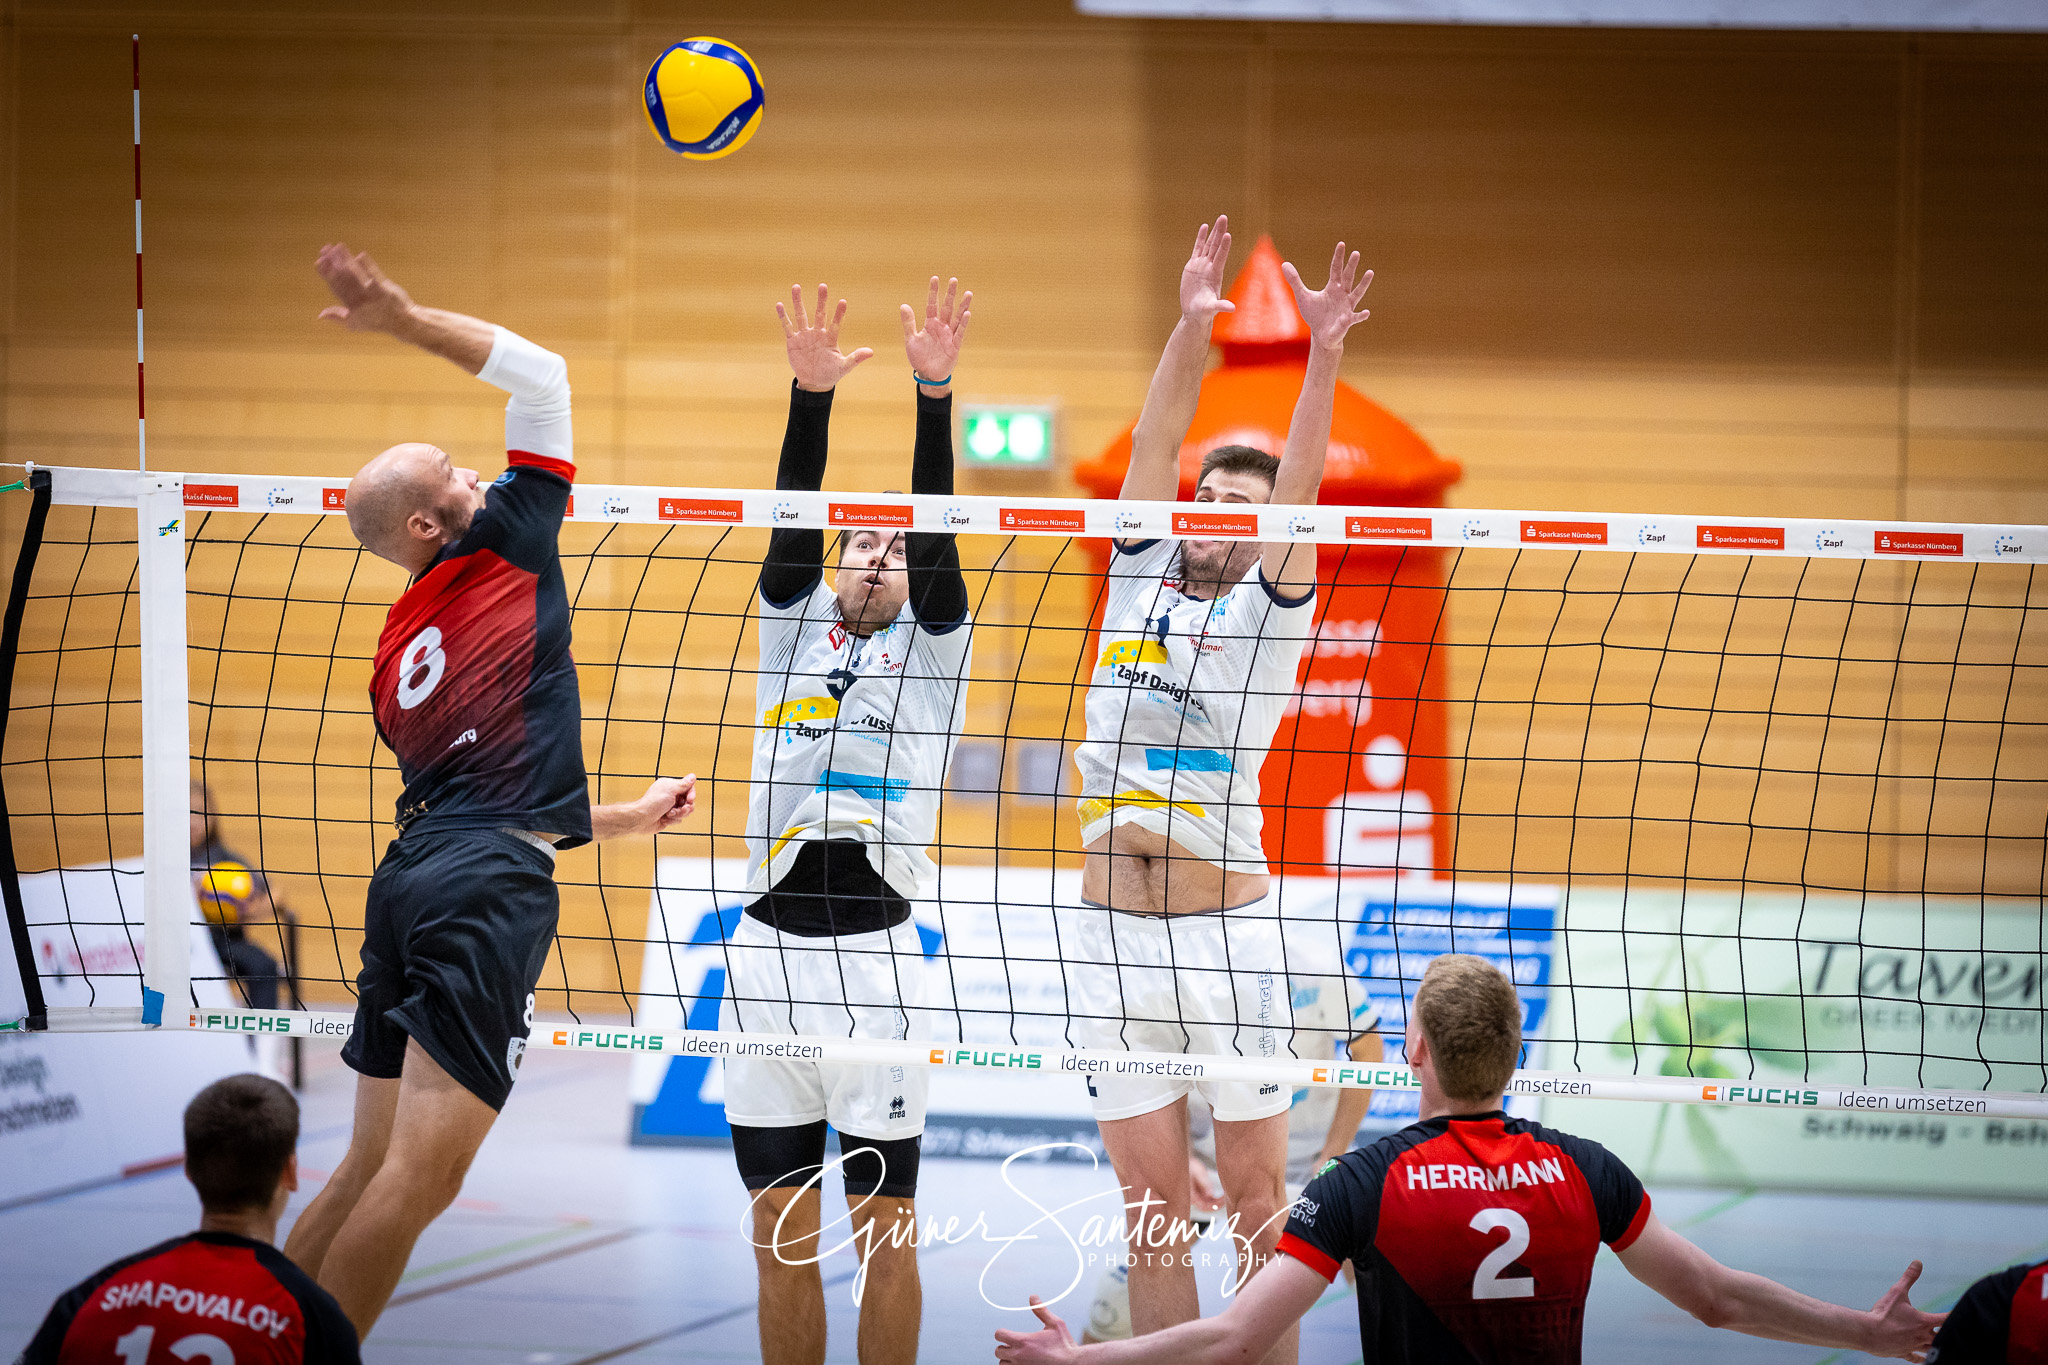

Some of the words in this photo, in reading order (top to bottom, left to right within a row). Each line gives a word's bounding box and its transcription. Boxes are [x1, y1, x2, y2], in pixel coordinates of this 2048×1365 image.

[183, 493, 204, 501] rkasse
[204, 494, 233, 503] Nürnberg
[275, 496, 294, 506] Zapf
[610, 506, 629, 515] Zapf
[676, 507, 706, 517] Sparkasse
[708, 508, 737, 518] Nürnberg
[780, 512, 799, 520] Zapf
[846, 513, 877, 522] Sparkasse
[878, 514, 908, 523] Nürnberg
[951, 516, 970, 525] Zapf
[1017, 518, 1048, 527] Sparkasse
[1049, 518, 1079, 528] Nürnberg
[1122, 521, 1142, 530] Zapf
[1190, 522, 1221, 531] Sparkasse
[1222, 523, 1252, 532] Nürnberg
[1296, 525, 1315, 534] Zapf
[1363, 526, 1395, 535] Sparkasse
[1396, 527, 1426, 536] Nürnberg
[1470, 529, 1490, 538] Zapf
[1538, 530, 1570, 540] Sparkasse
[1571, 531, 1602, 541] Nürnberg
[1646, 534, 1666, 543] Zapf
[1715, 535, 1747, 545] Sparkasse
[1748, 536, 1779, 546] Nürnberg
[1823, 539, 1844, 548] Zapf
[1892, 541, 1926, 551] Sparkasse
[1926, 542, 1957, 552] Nürnberg
[2002, 545, 2023, 554] Zapf
[396, 626, 446, 710] 8
[523, 992, 536, 1029] 8
[207, 1014, 291, 1033] FUCHS
[578, 1032, 664, 1051] FUCHS
[682, 1036, 729, 1054] Ideen
[736, 1040, 823, 1059] umsetzen
[955, 1050, 1042, 1069] FUCHS
[1061, 1054, 1109, 1072] Ideen
[1116, 1058, 1204, 1077] umsetzen
[1729, 1087, 1818, 1106] FUCHS
[1838, 1091, 1889, 1109] Ideen
[1895, 1093, 1987, 1113] umsetzen
[1406, 1157, 1565, 1192] HERRMANN
[1469, 1208, 1535, 1300] 2
